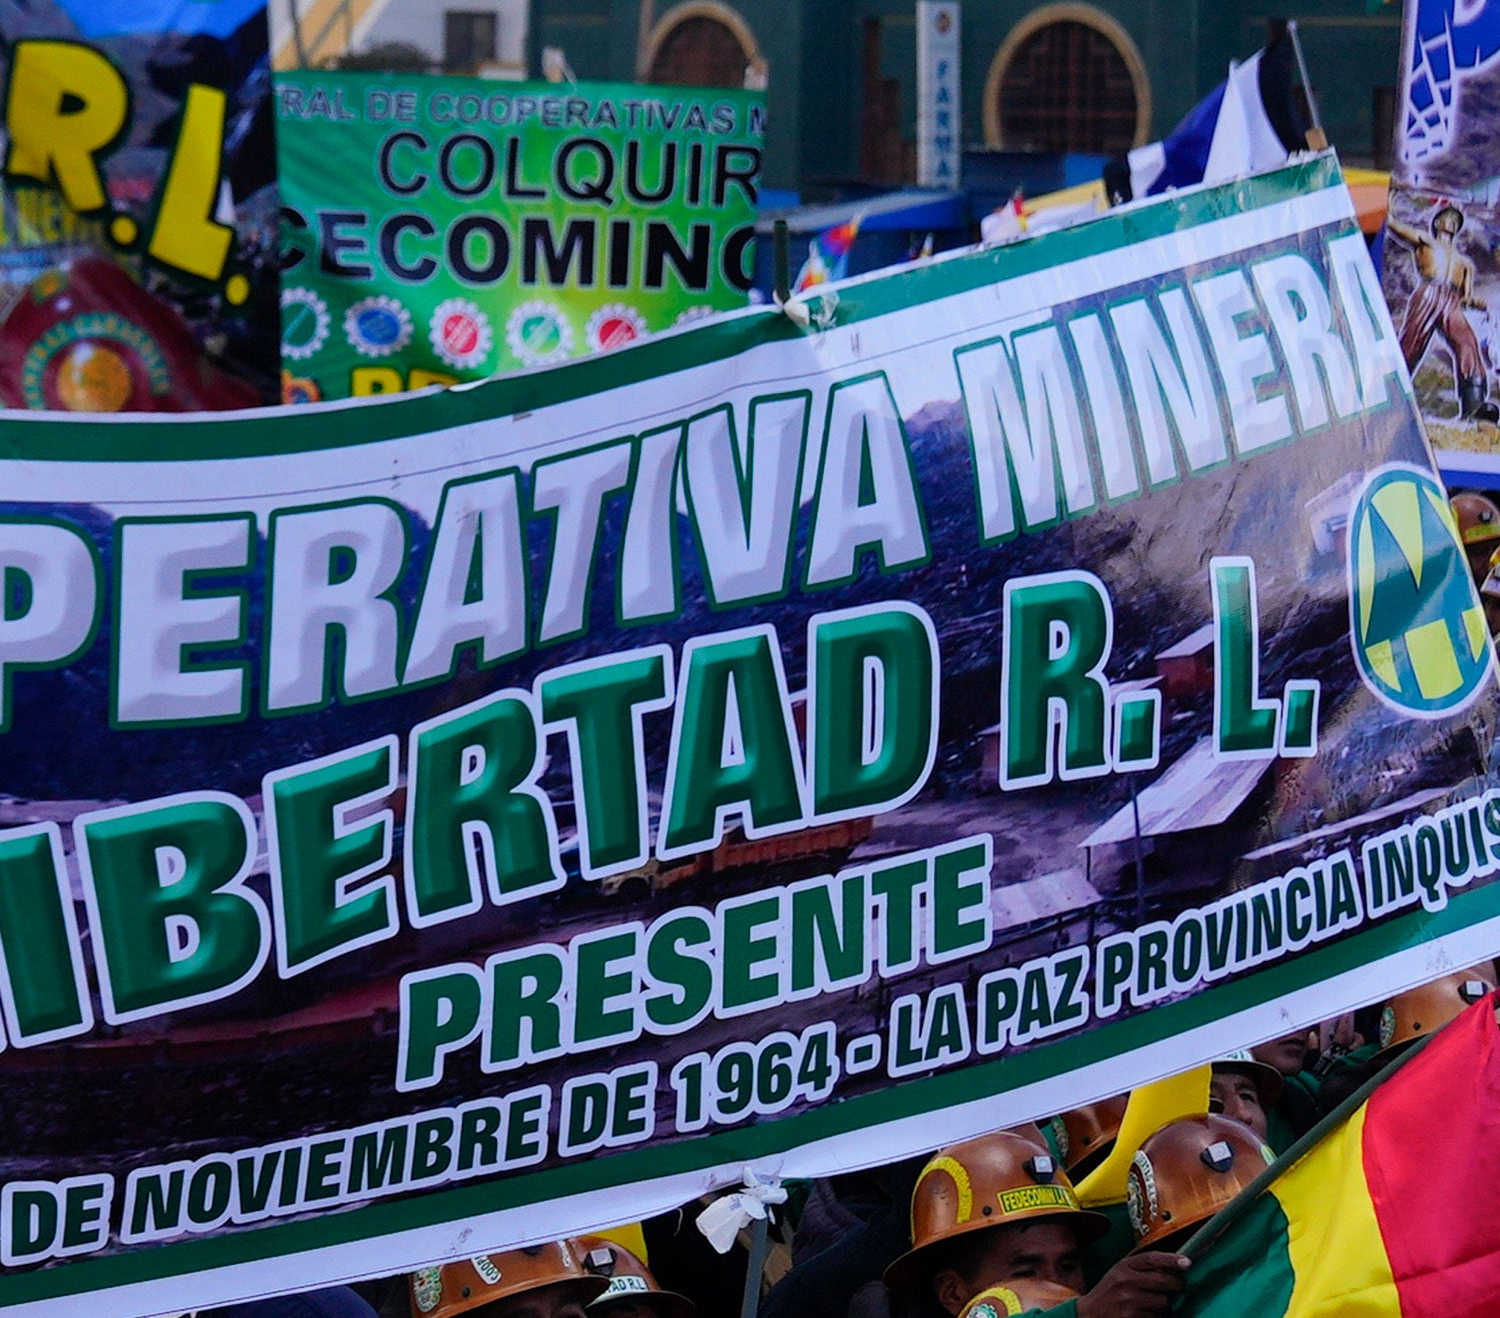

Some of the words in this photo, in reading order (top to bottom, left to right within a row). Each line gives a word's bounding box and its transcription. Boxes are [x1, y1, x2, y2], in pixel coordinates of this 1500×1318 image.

[365, 89, 417, 122] DE
[429, 92, 735, 134] COOPERATIVAS
[936, 61, 950, 178] FARMA
[946, 229, 1417, 550] MINERA
[1, 1171, 117, 1262] DE
[127, 1093, 551, 1251] NOVIEMBRE
[557, 1066, 655, 1162] DE
[670, 1021, 835, 1136] 1964
[885, 984, 975, 1078] LA
[981, 942, 1094, 1053] PAZ
[1094, 855, 1358, 1012] PROVINCIA
[395, 832, 996, 1091] PRESENTE
